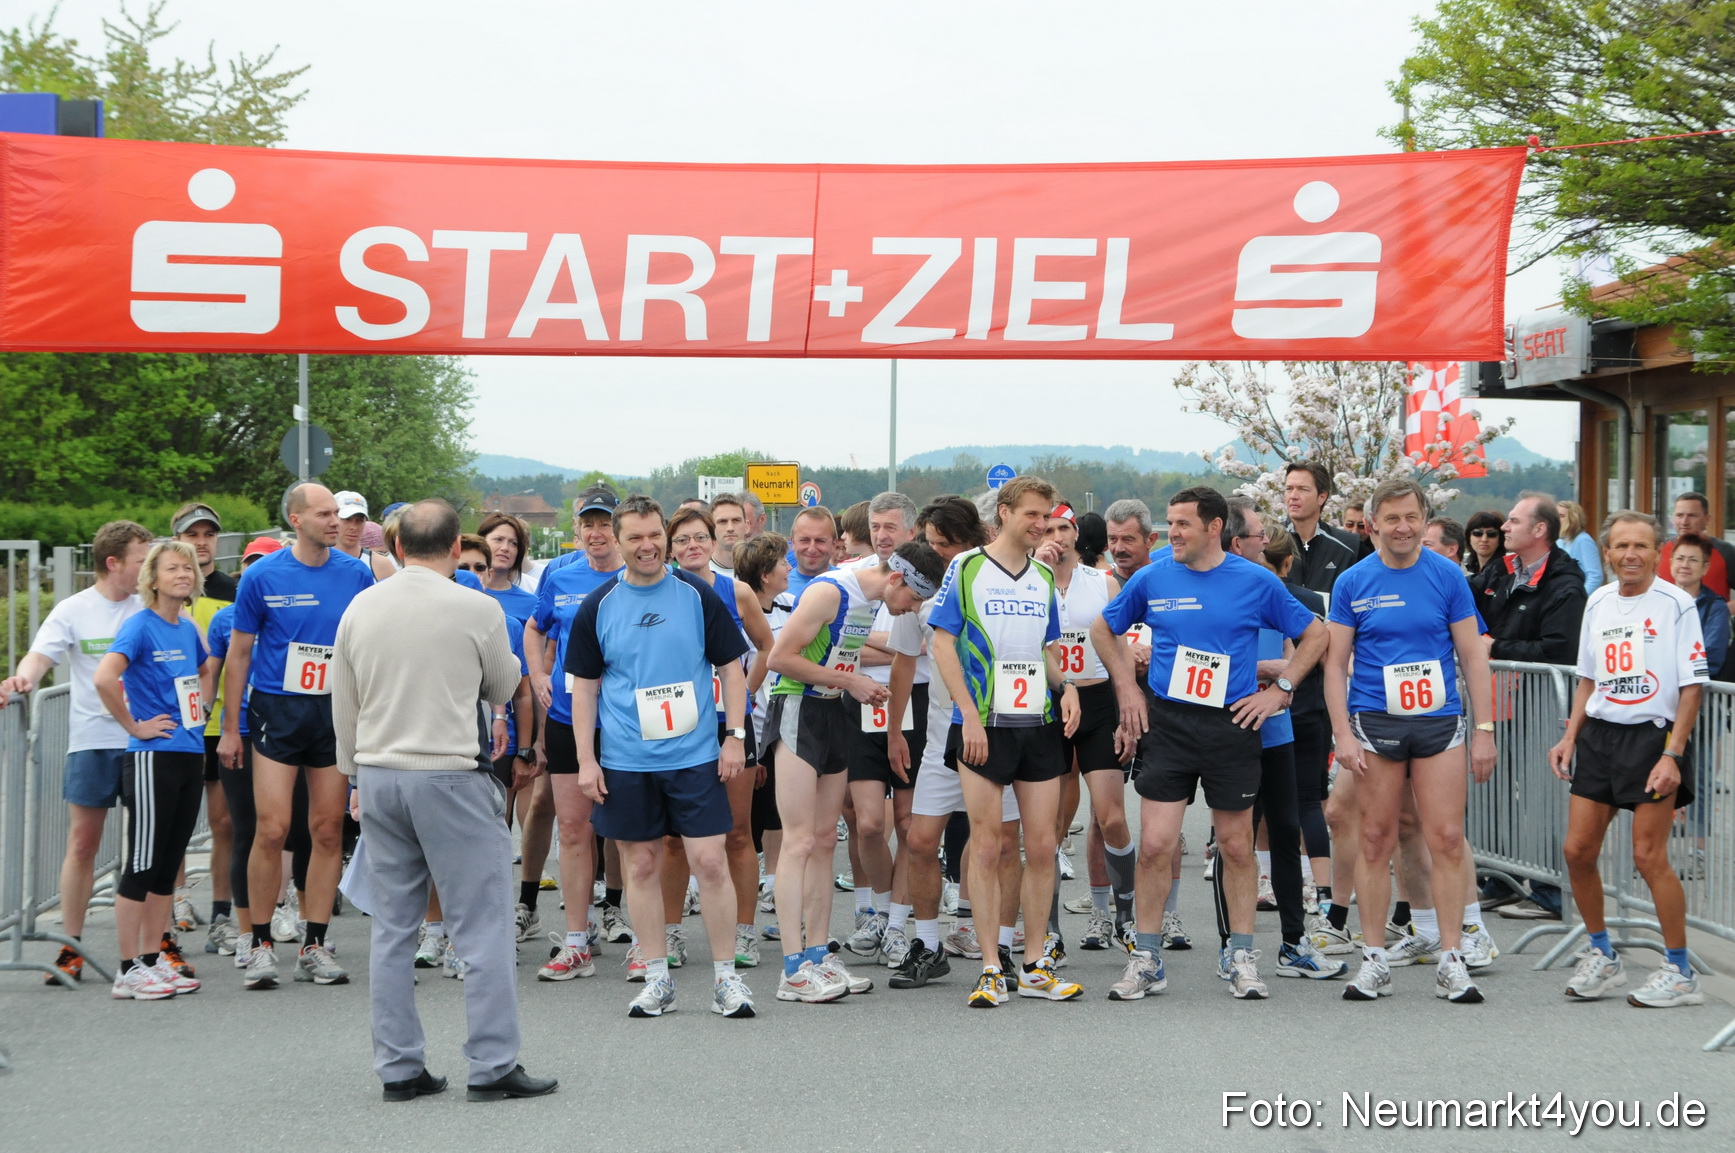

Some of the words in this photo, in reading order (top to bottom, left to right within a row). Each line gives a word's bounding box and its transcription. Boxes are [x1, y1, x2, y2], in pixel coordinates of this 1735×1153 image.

[1523, 327, 1568, 362] SEAT
[752, 479, 795, 489] Neumarkt
[803, 489, 816, 501] 60
[986, 588, 1016, 596] TEAM
[985, 599, 1046, 618] BOCK
[844, 624, 871, 637] BOCK
[1602, 627, 1623, 637] MEYER
[297, 645, 324, 655] MEYER
[837, 650, 855, 658] MEYER
[1185, 650, 1210, 662] MEYER
[1184, 657, 1210, 668] WERBUNG
[1604, 641, 1633, 674] 86
[1393, 664, 1421, 674] MEYER
[1394, 670, 1422, 679] WERBUNG
[300, 661, 328, 691] 61
[1186, 665, 1214, 699] 16
[645, 687, 672, 697] MEYER
[646, 693, 674, 702] WERBUNG
[1013, 677, 1028, 709] 2
[1399, 678, 1433, 711] 66
[660, 700, 674, 731] 1
